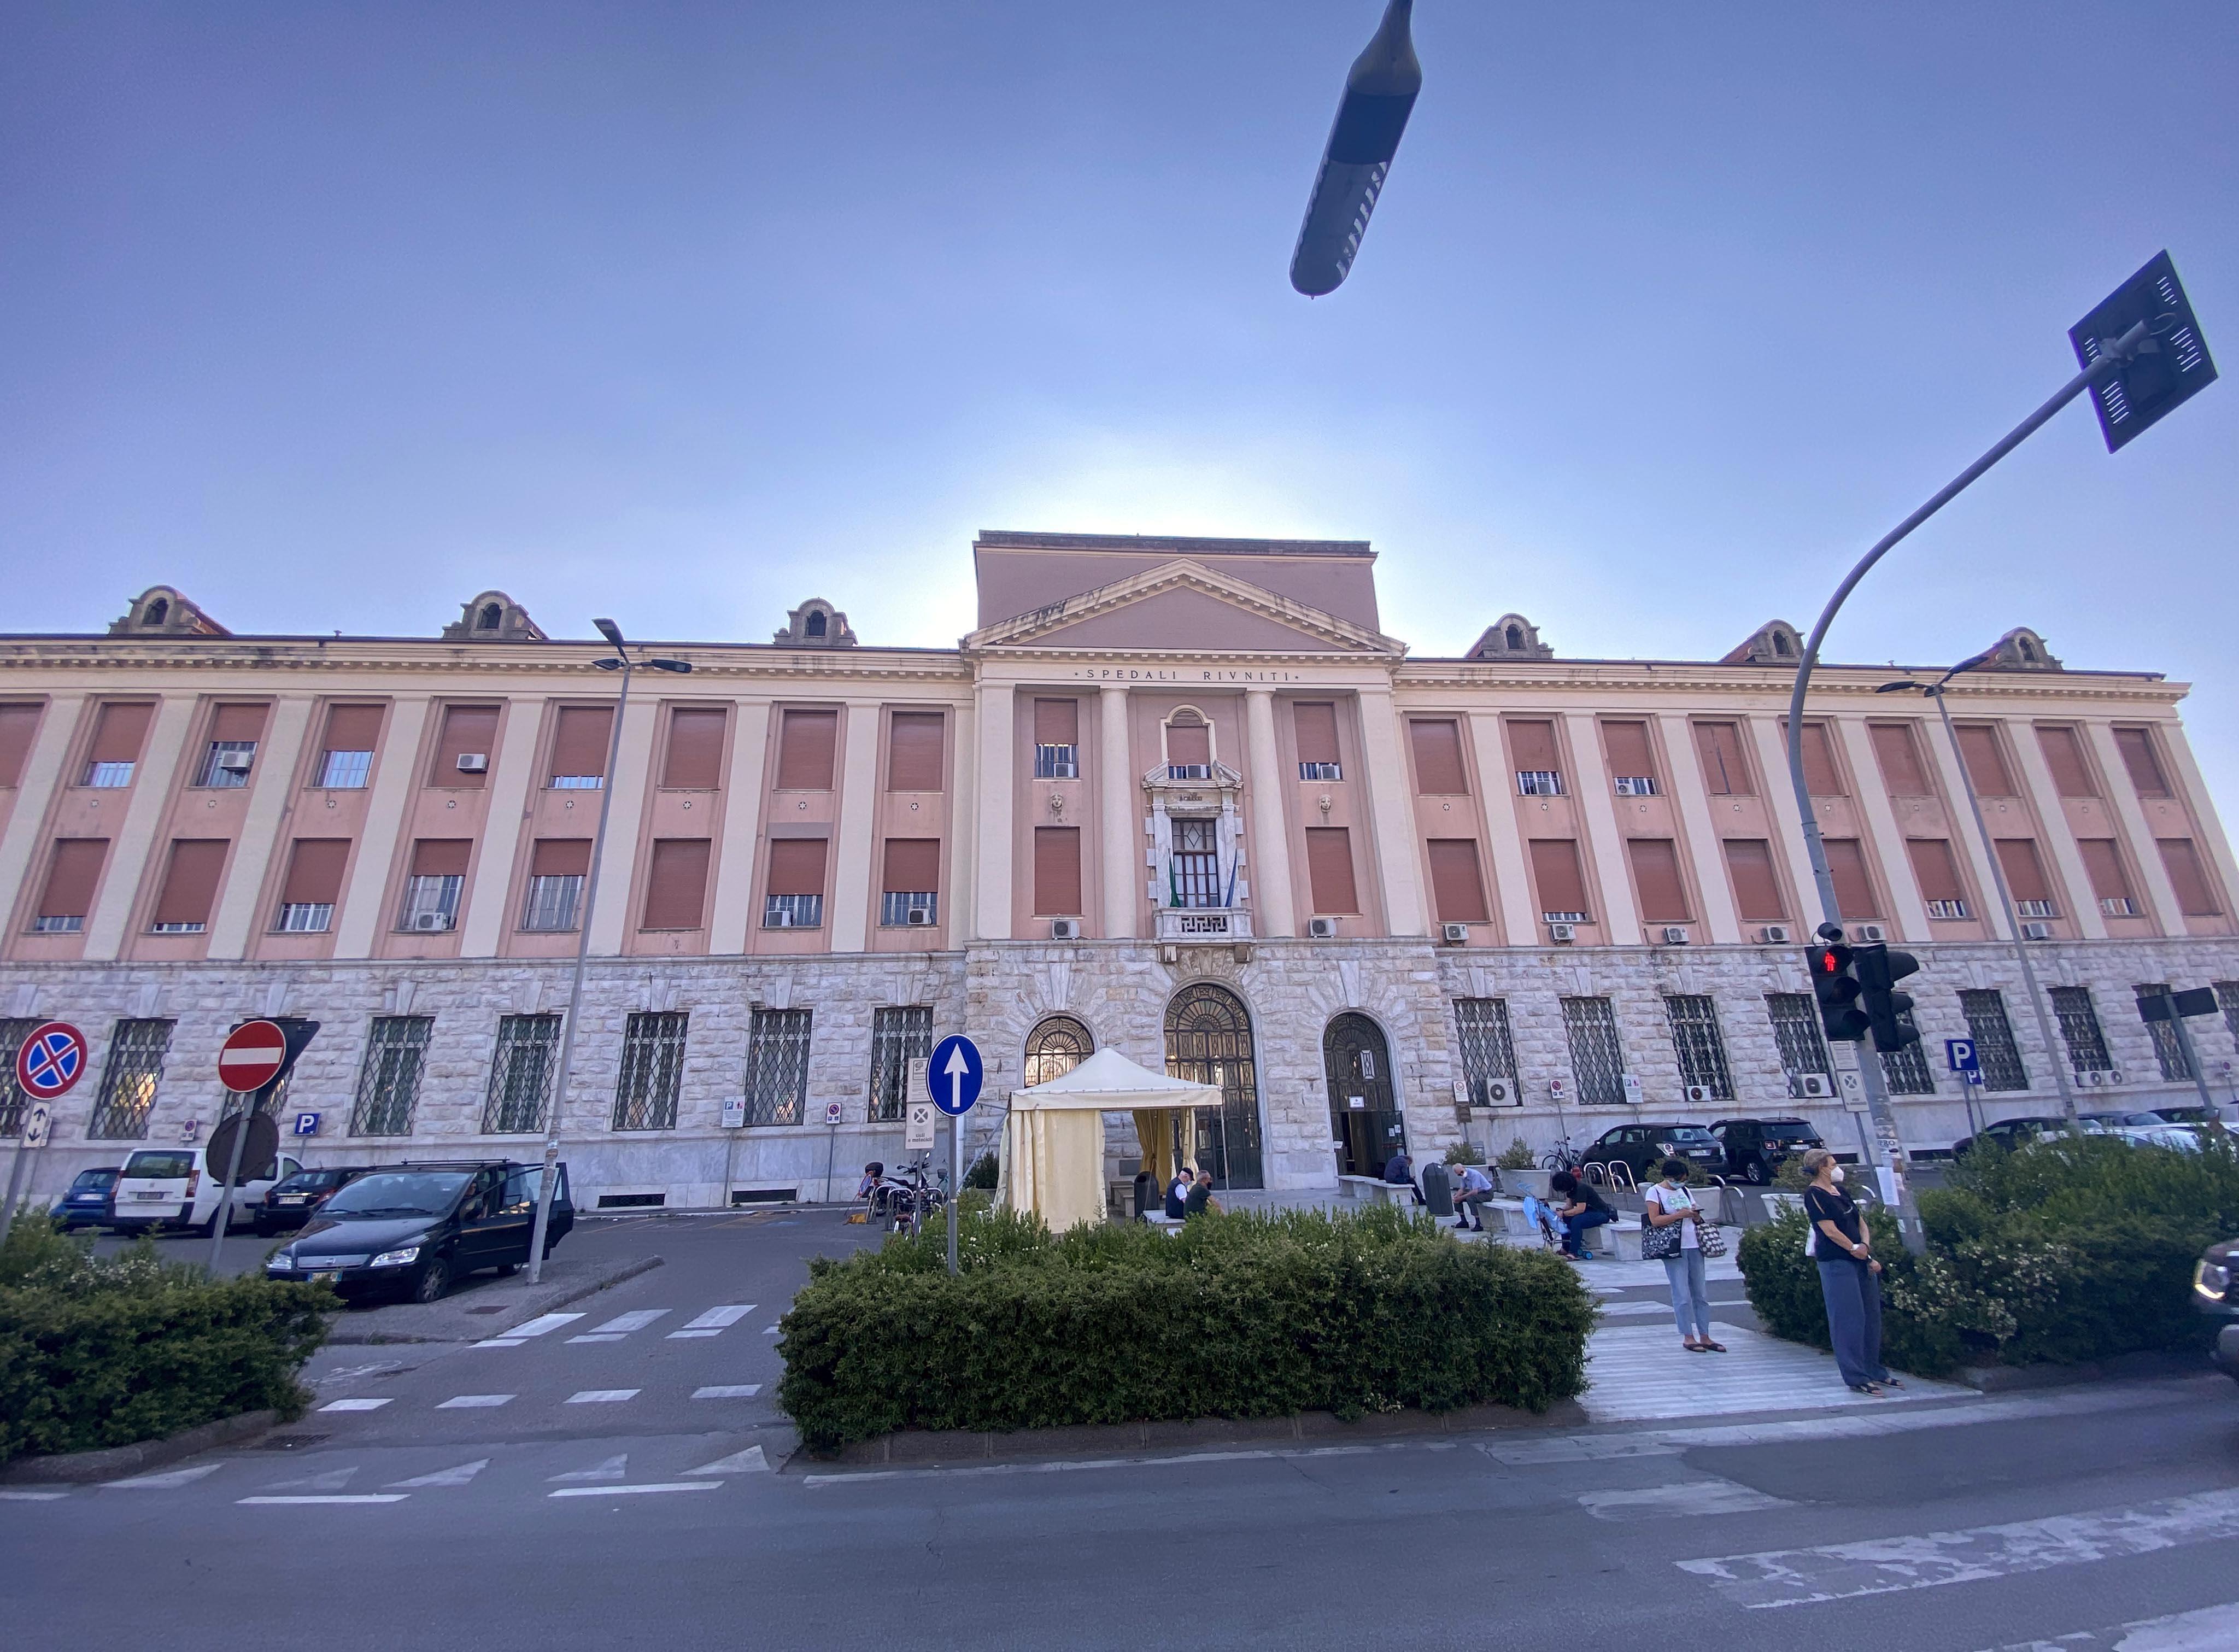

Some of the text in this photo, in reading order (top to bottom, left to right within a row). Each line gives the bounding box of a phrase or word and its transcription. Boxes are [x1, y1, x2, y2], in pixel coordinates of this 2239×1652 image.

[1087, 670, 1288, 681] SPEDALI RIVNITI
[1952, 1042, 1971, 1069] P
[1968, 1071, 1977, 1083] P
[298, 1115, 314, 1133] P
